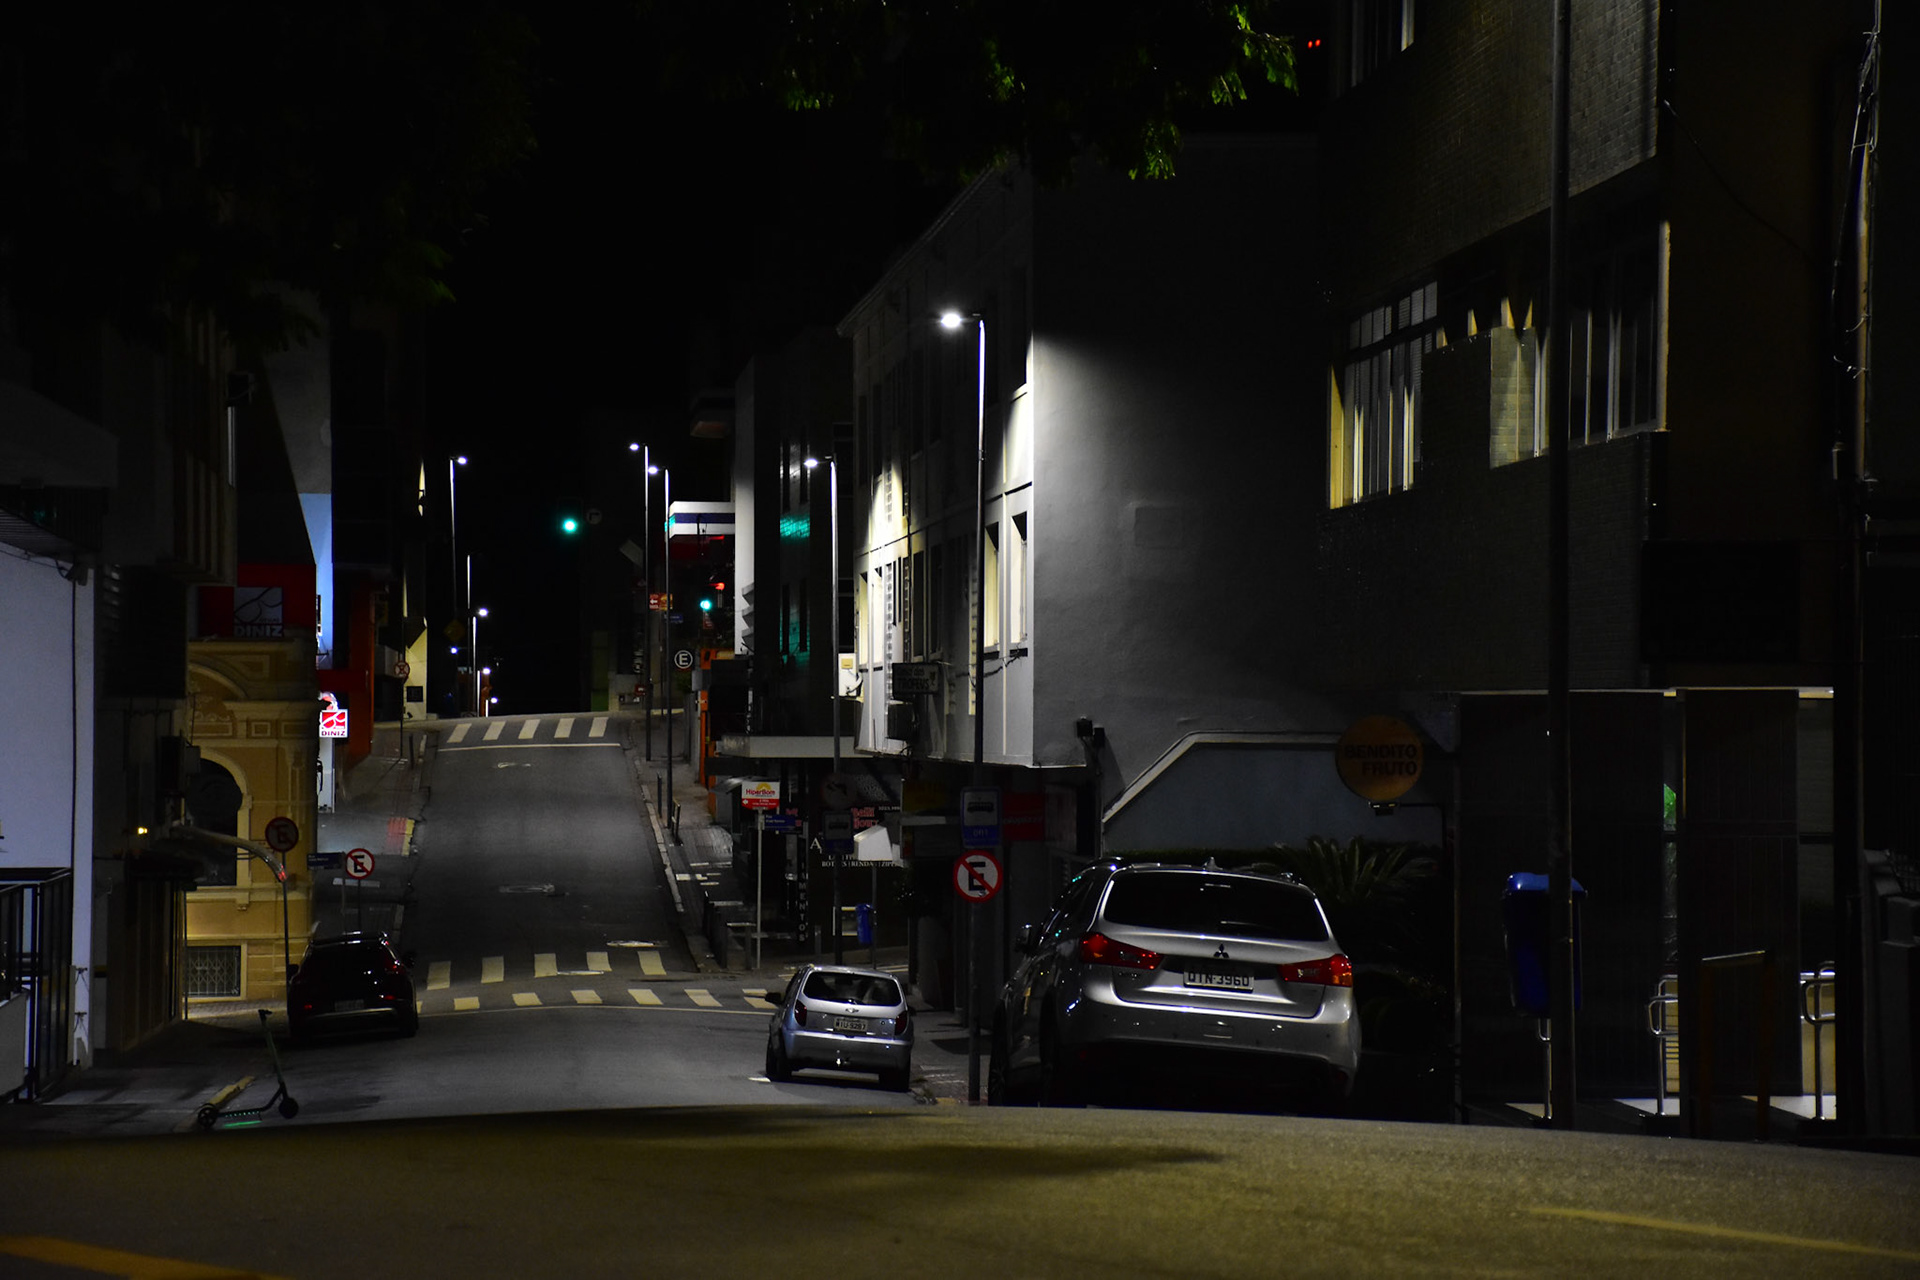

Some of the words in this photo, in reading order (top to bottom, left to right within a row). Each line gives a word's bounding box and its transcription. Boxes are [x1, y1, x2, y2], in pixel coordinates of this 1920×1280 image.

[234, 625, 283, 638] DINIZ
[1345, 745, 1417, 758] BENDITO
[1362, 761, 1417, 775] FRUTO
